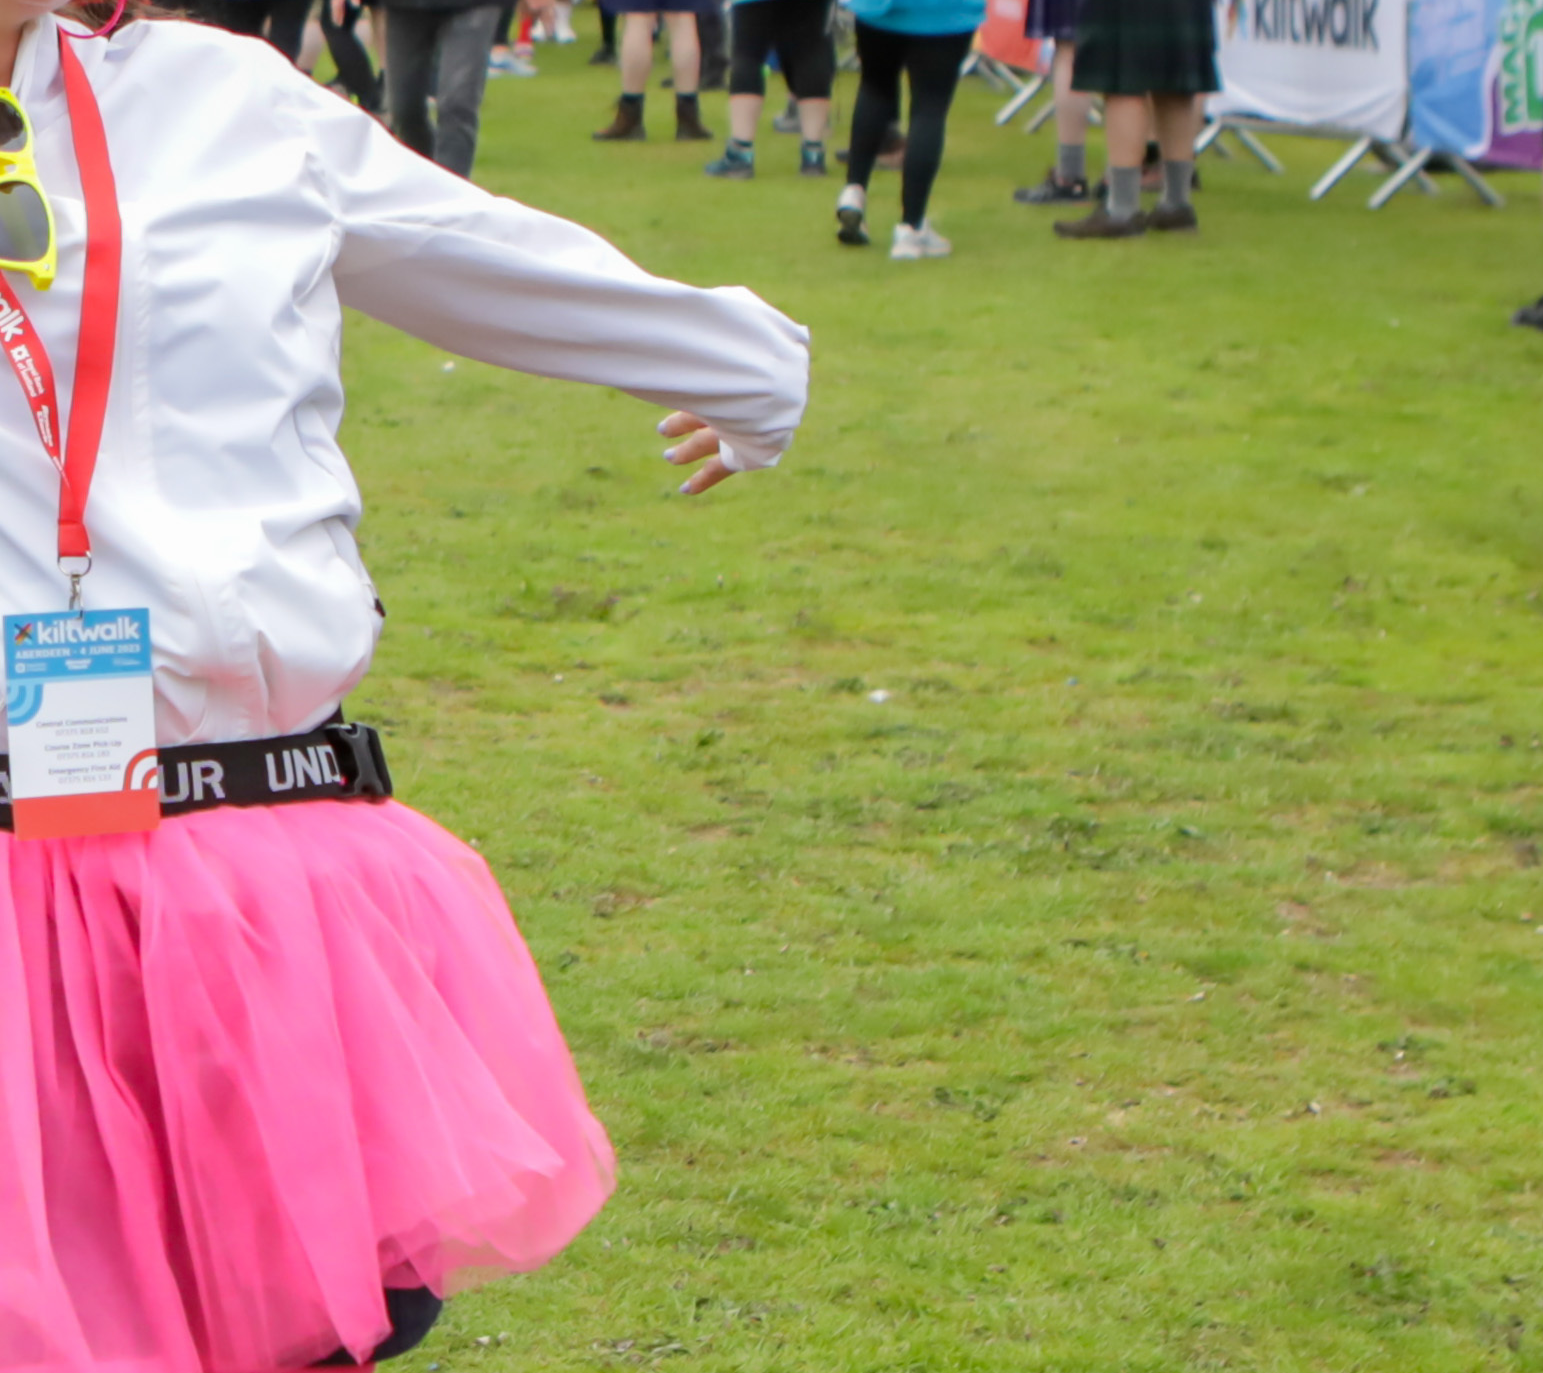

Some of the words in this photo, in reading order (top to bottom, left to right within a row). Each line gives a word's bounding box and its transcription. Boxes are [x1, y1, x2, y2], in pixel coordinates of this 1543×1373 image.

[37, 616, 141, 645] kiltwalk
[15, 647, 71, 660] ABERDEEN
[89, 644, 115, 655] JUNE
[264, 745, 342, 794] UND
